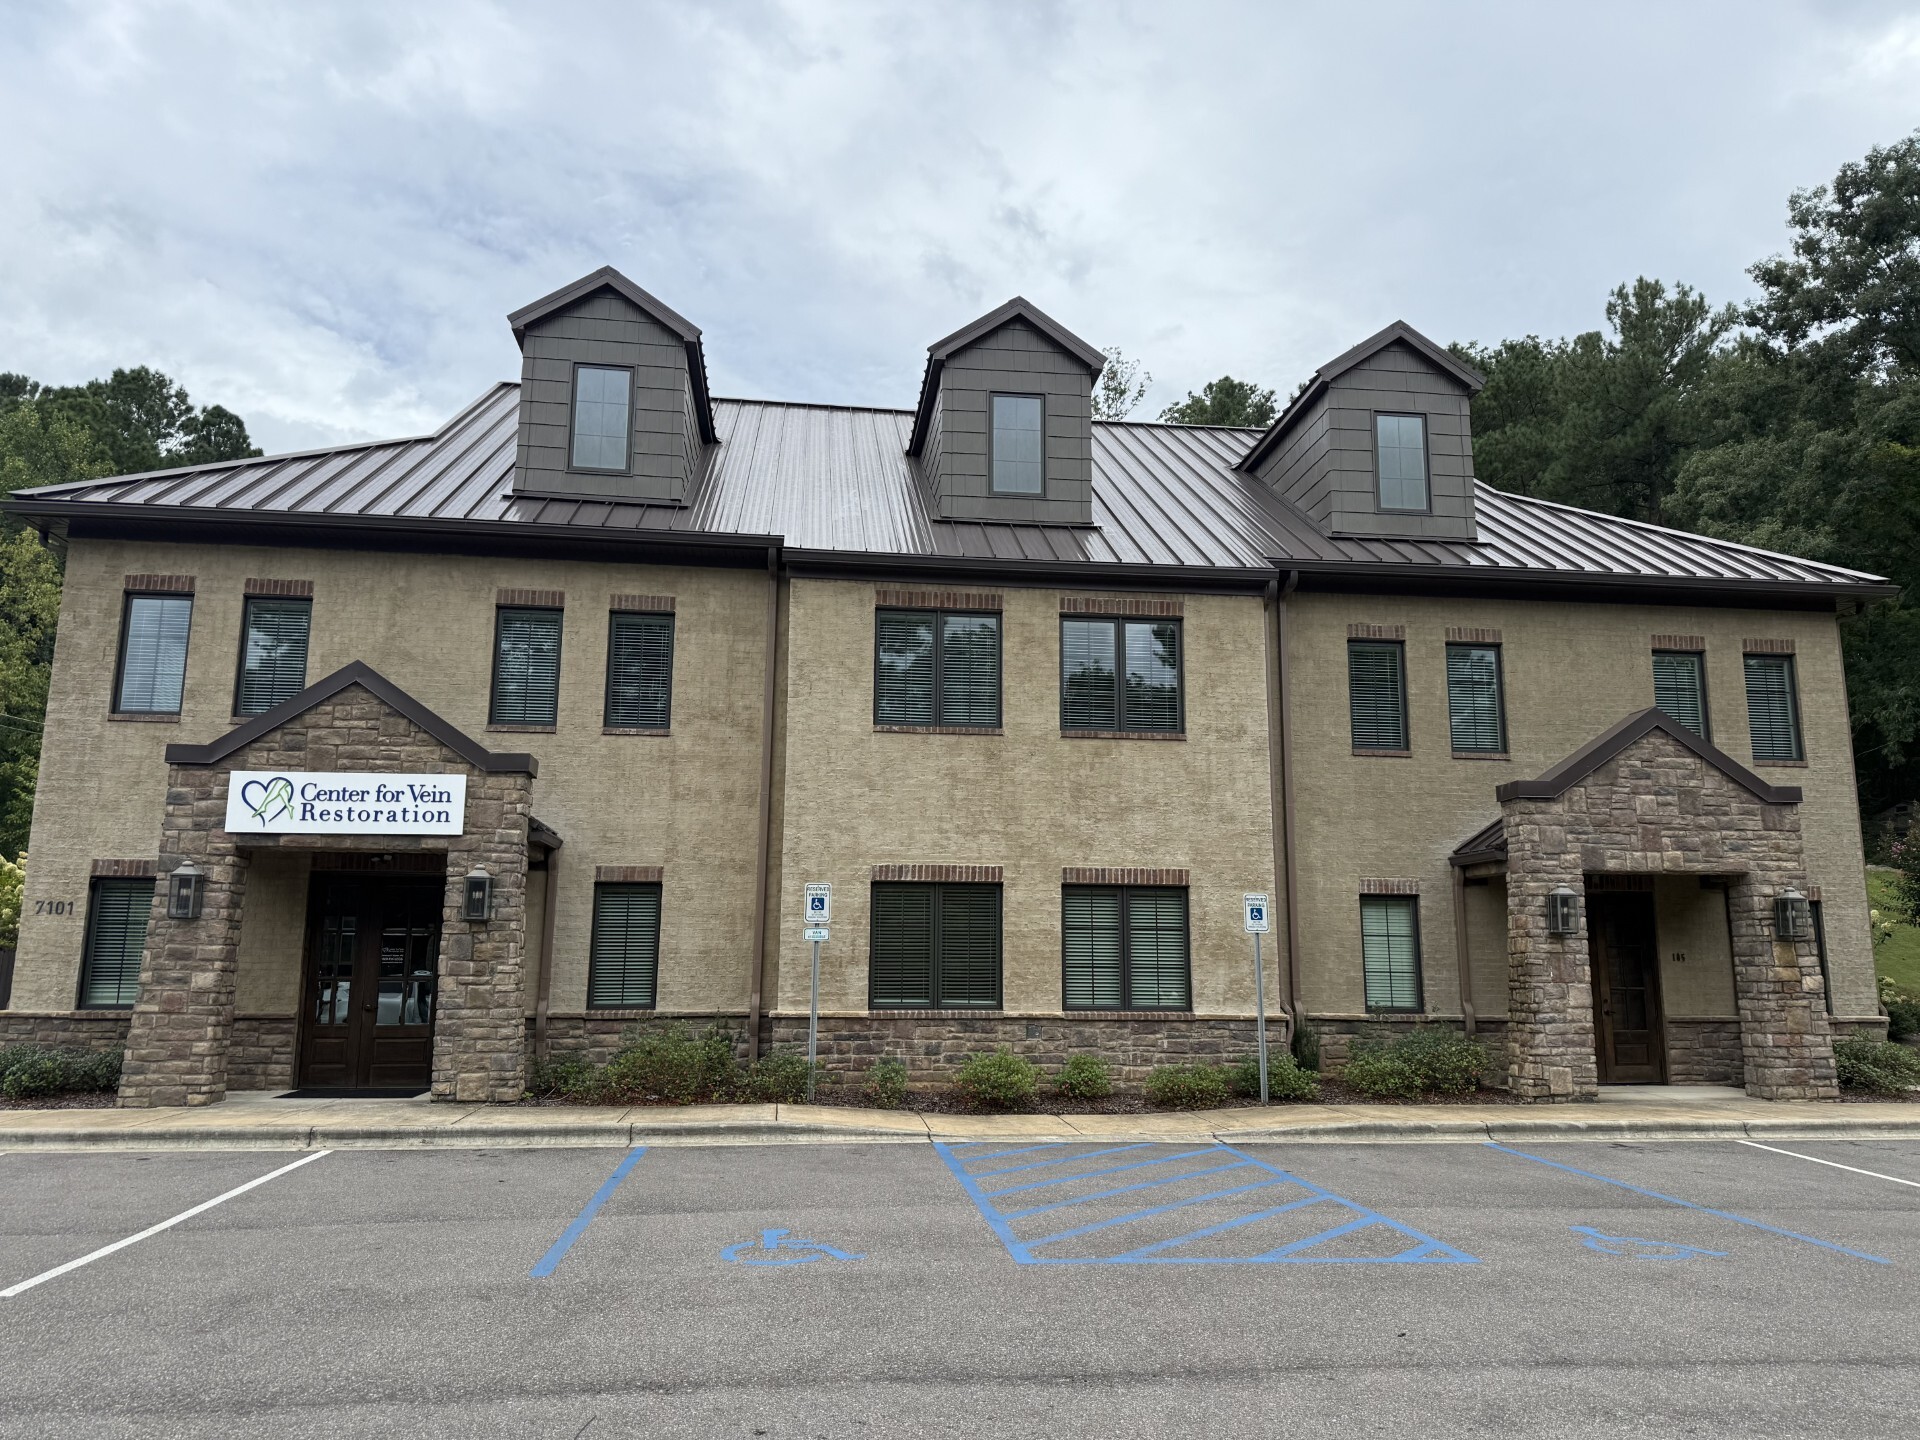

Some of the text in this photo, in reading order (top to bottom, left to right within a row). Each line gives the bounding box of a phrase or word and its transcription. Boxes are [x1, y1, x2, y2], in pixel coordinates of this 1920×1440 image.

[300, 782, 452, 803] Center for Vein
[299, 802, 451, 823] Restoration
[35, 900, 74, 916] 7101
[1672, 952, 1686, 962] 105
